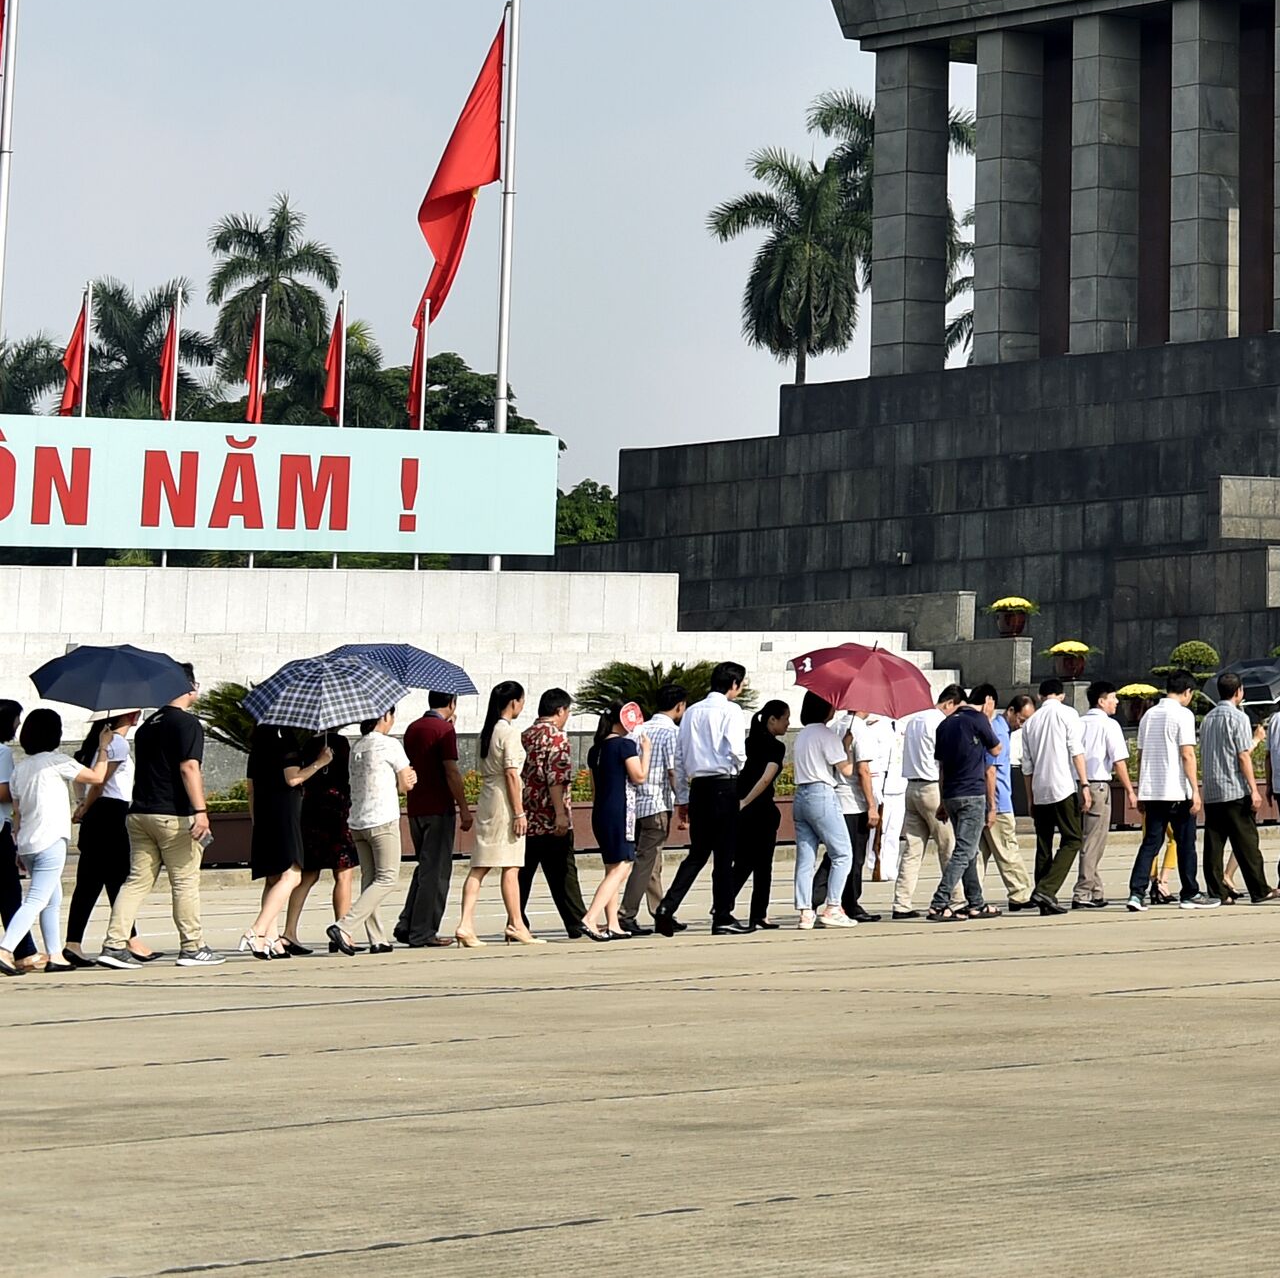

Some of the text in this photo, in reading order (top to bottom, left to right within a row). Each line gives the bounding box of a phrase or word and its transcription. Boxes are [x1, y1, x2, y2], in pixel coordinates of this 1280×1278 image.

[0, 428, 420, 532] N NĂM !
